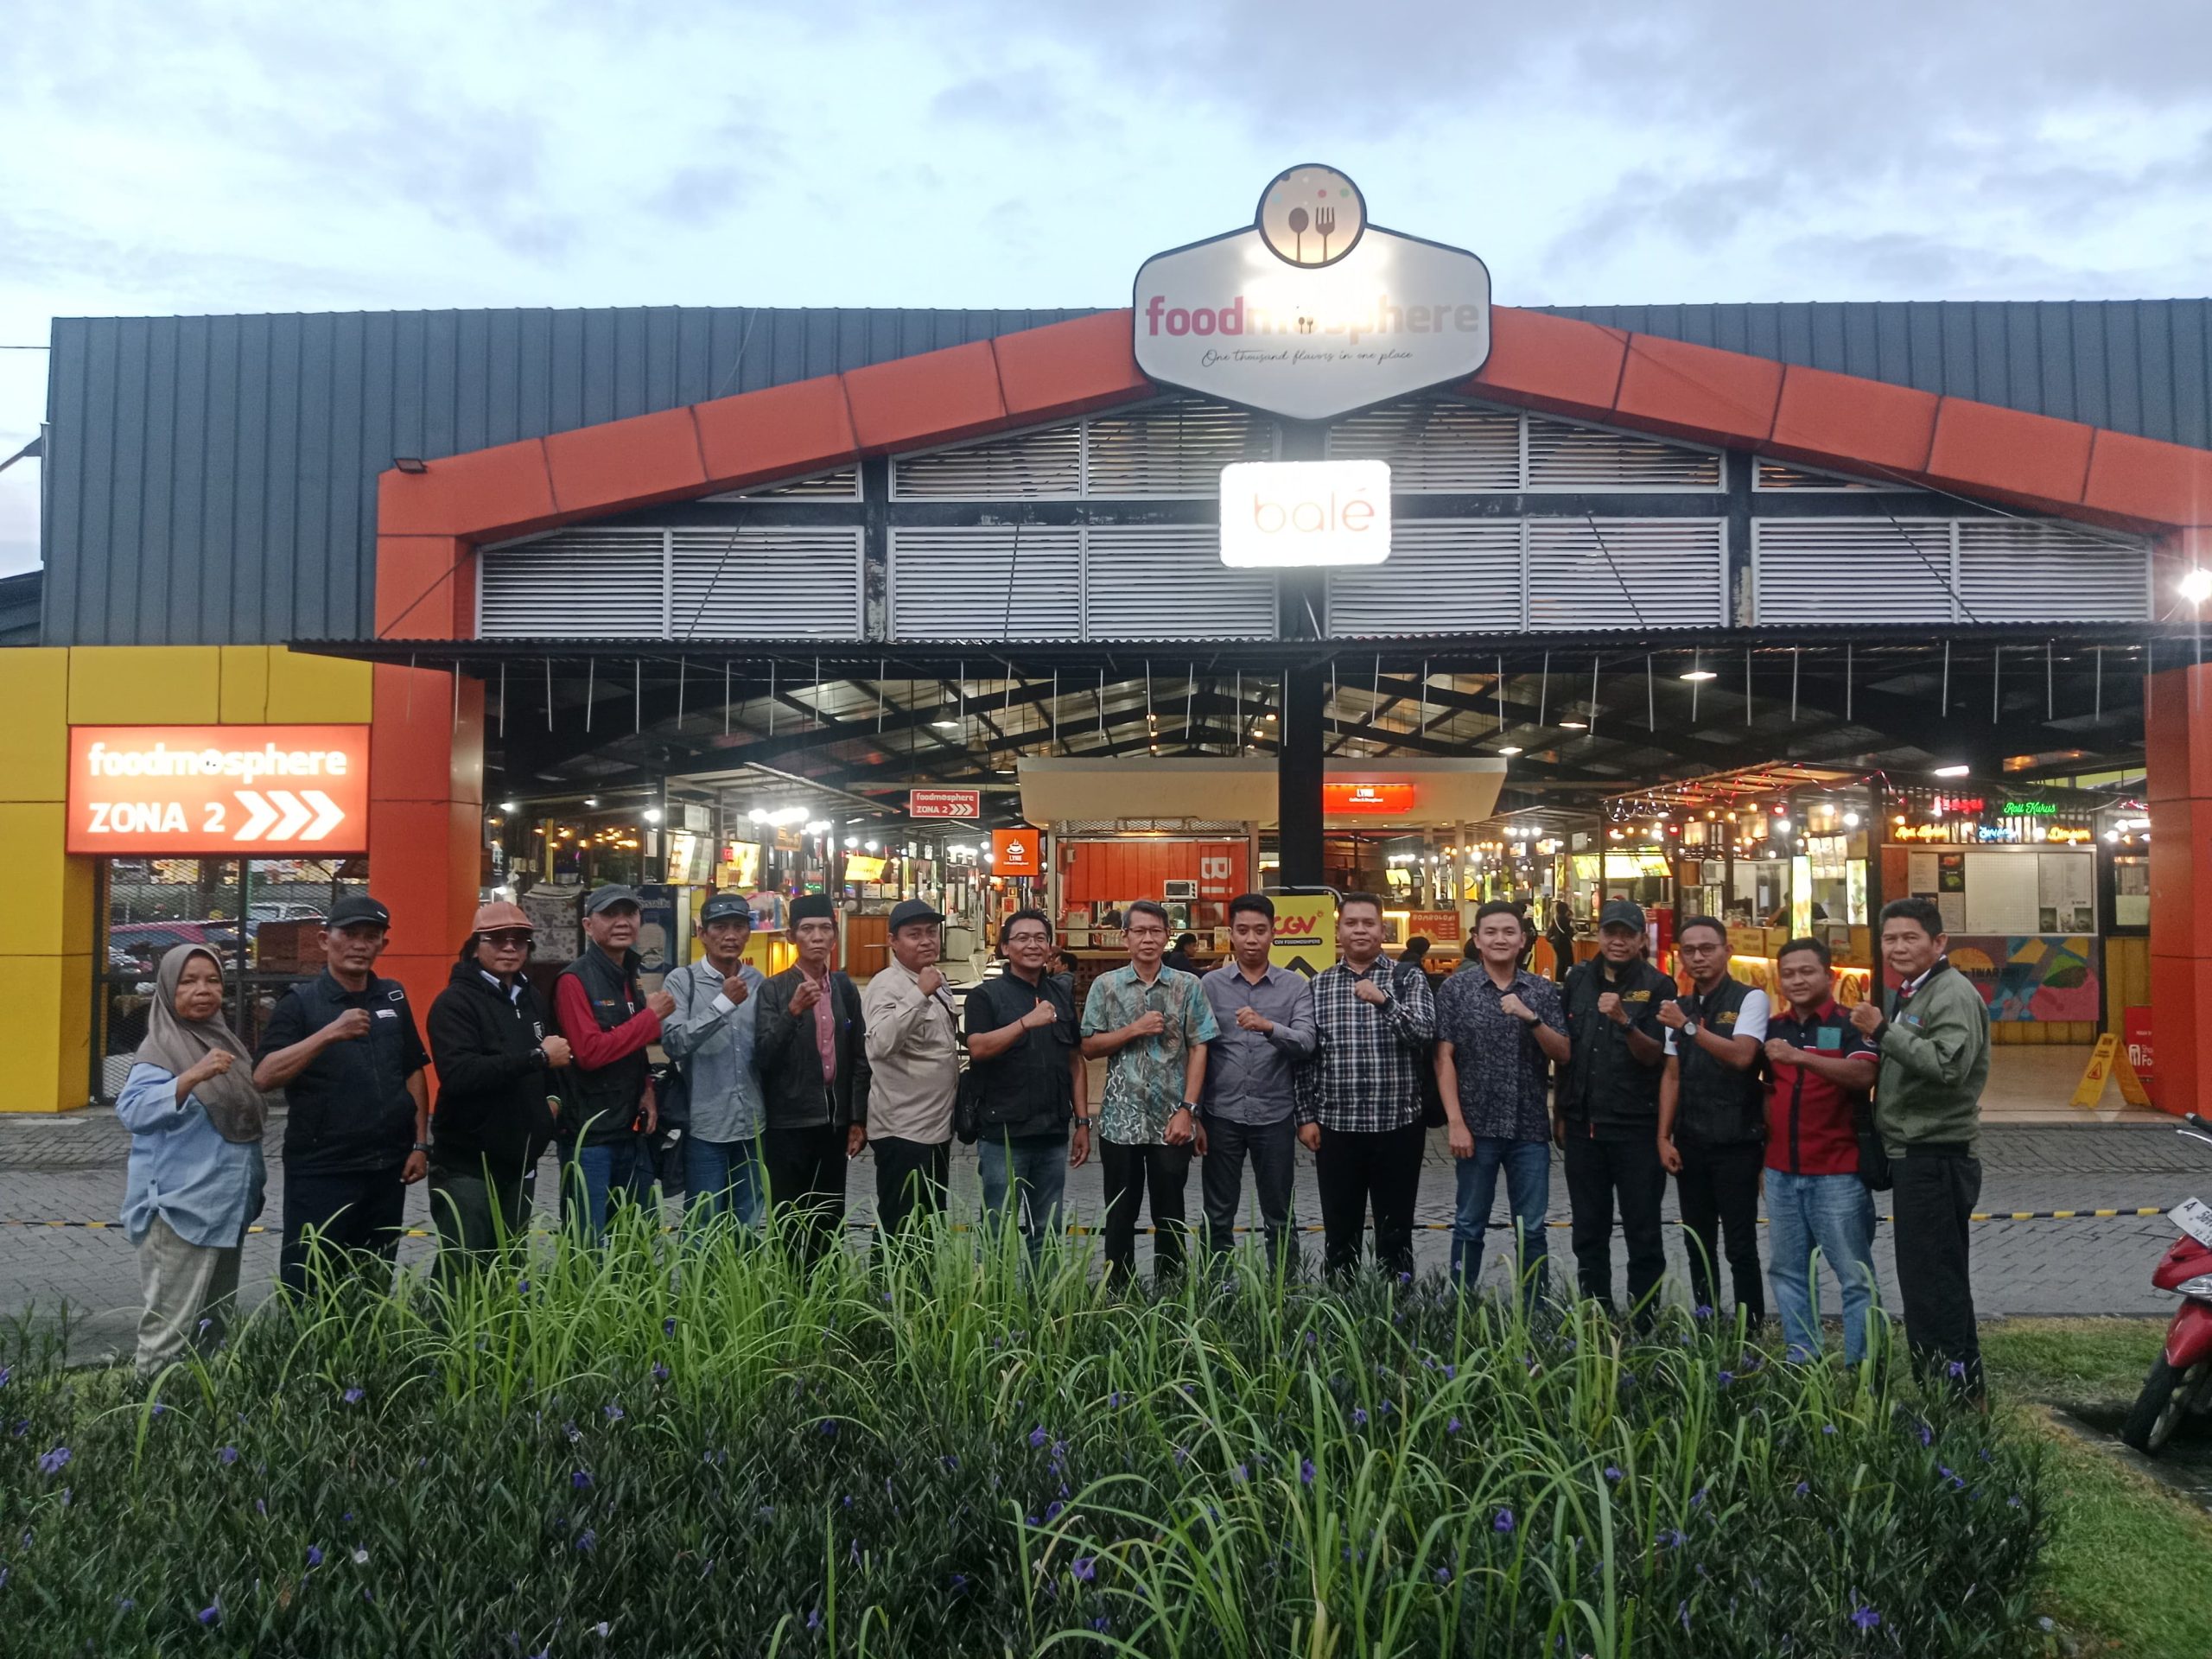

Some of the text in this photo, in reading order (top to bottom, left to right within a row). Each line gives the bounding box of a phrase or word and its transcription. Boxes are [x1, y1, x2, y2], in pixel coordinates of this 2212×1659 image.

[1202, 349, 1230, 367] One
[1233, 349, 1287, 363] thousand
[1292, 350, 1333, 365] flavors
[1339, 350, 1351, 360] in
[1377, 349, 1412, 365] place
[1255, 487, 1375, 533] balé
[87, 742, 346, 784] foodmosphere
[917, 792, 974, 803] foodmosphere
[87, 802, 226, 833] ZONA 2
[2183, 1202, 2197, 1211] A
